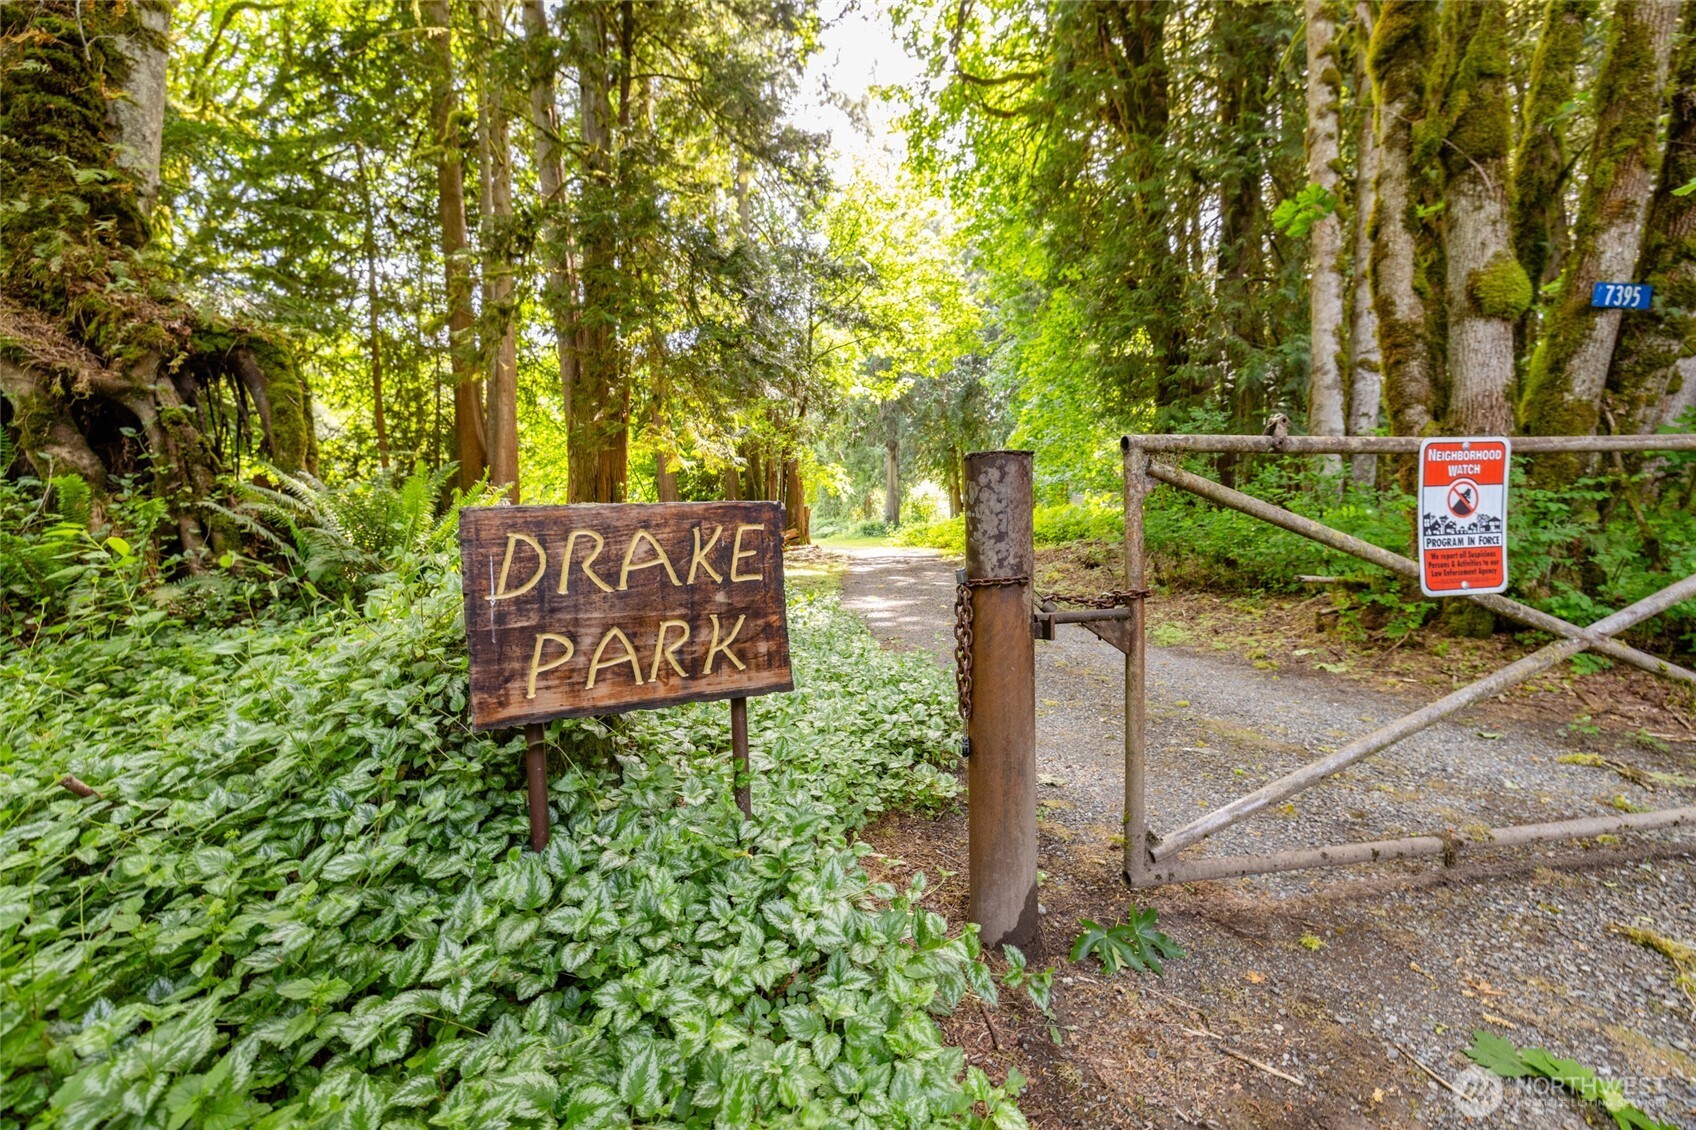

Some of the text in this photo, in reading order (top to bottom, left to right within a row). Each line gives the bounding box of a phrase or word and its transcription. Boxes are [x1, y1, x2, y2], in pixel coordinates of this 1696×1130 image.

[1605, 285, 1642, 307] 7395
[1427, 448, 1503, 461] NEIGHBORHOOD
[1448, 464, 1481, 477] WATCH
[1426, 536, 1465, 548] PROGRAM
[1478, 534, 1500, 546] FORCE
[484, 523, 765, 600] DRAKE
[526, 613, 747, 699] PARK
